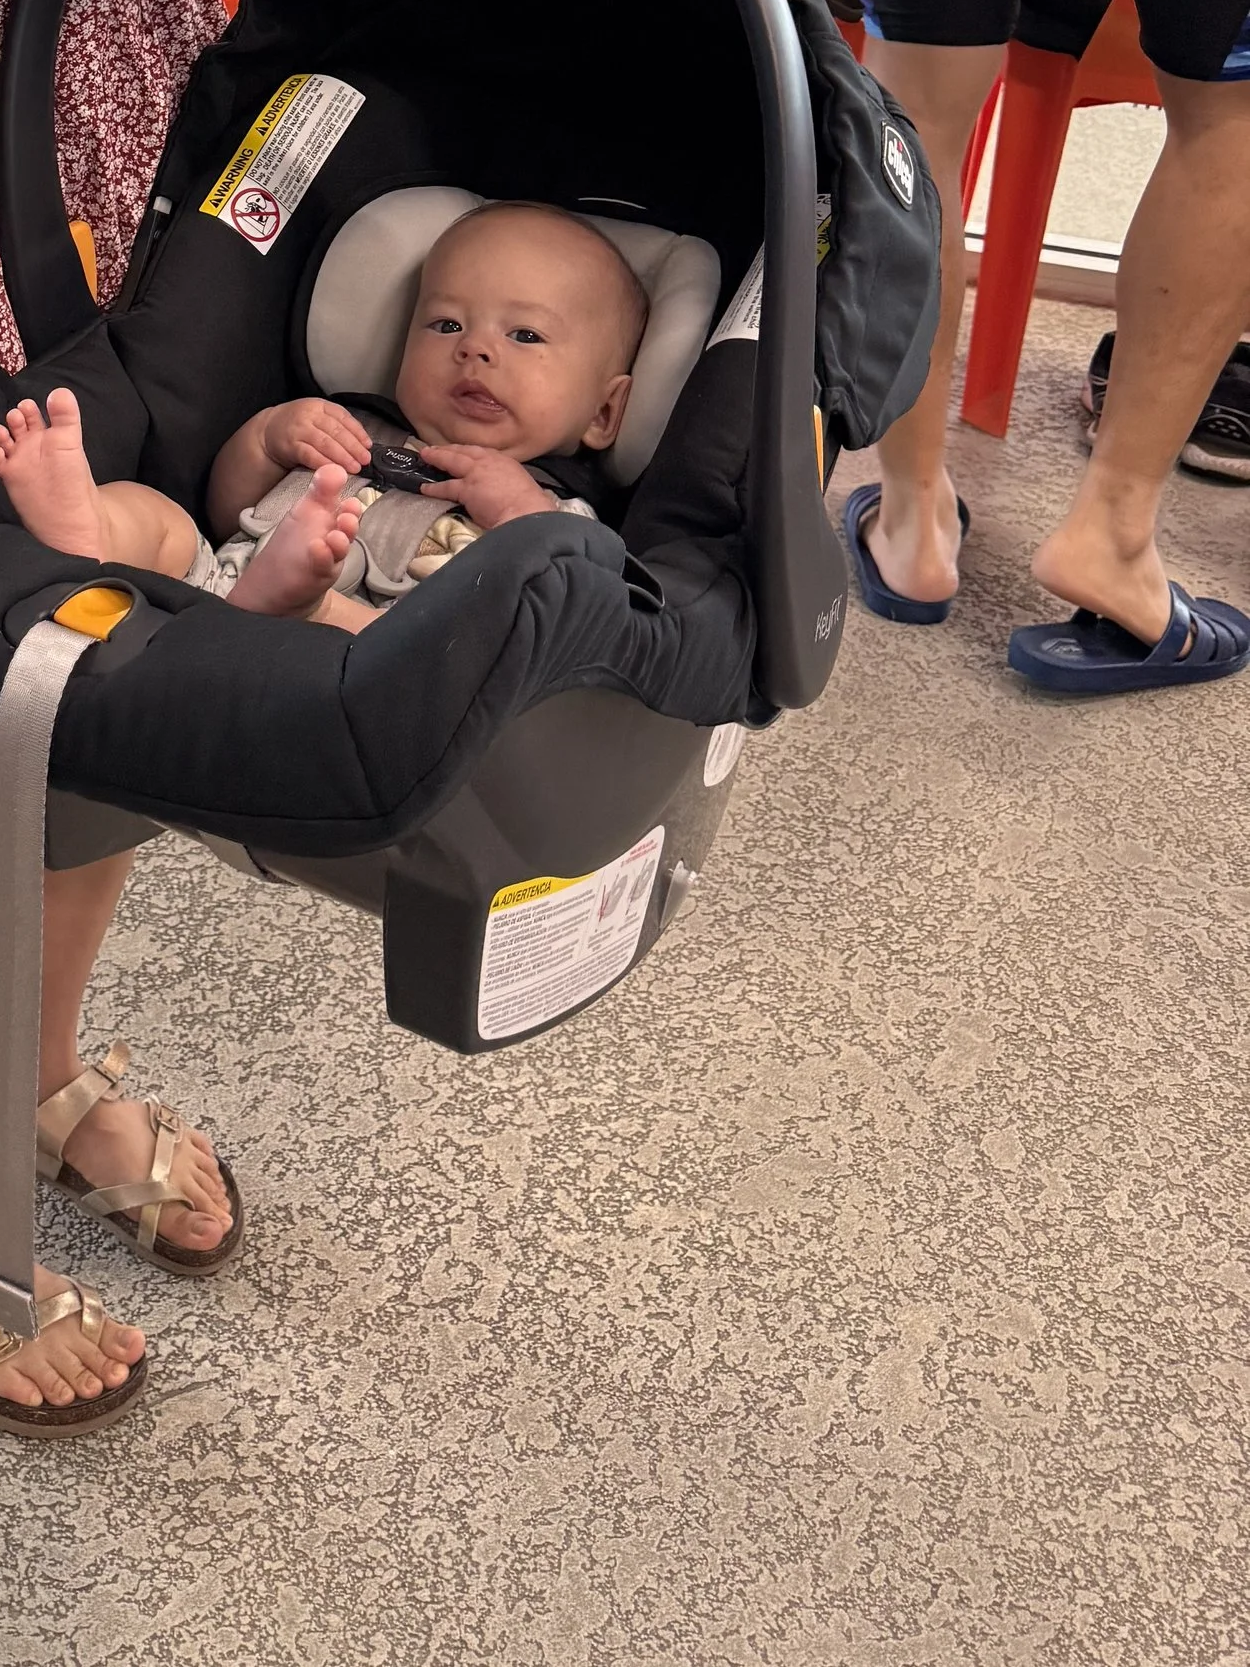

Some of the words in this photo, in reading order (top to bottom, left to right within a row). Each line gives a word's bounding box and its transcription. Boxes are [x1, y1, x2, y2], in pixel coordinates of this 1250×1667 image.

[215, 147, 254, 198] WARNING
[262, 151, 277, 171] DEATH
[500, 880, 552, 907] ADVERTENCIA
